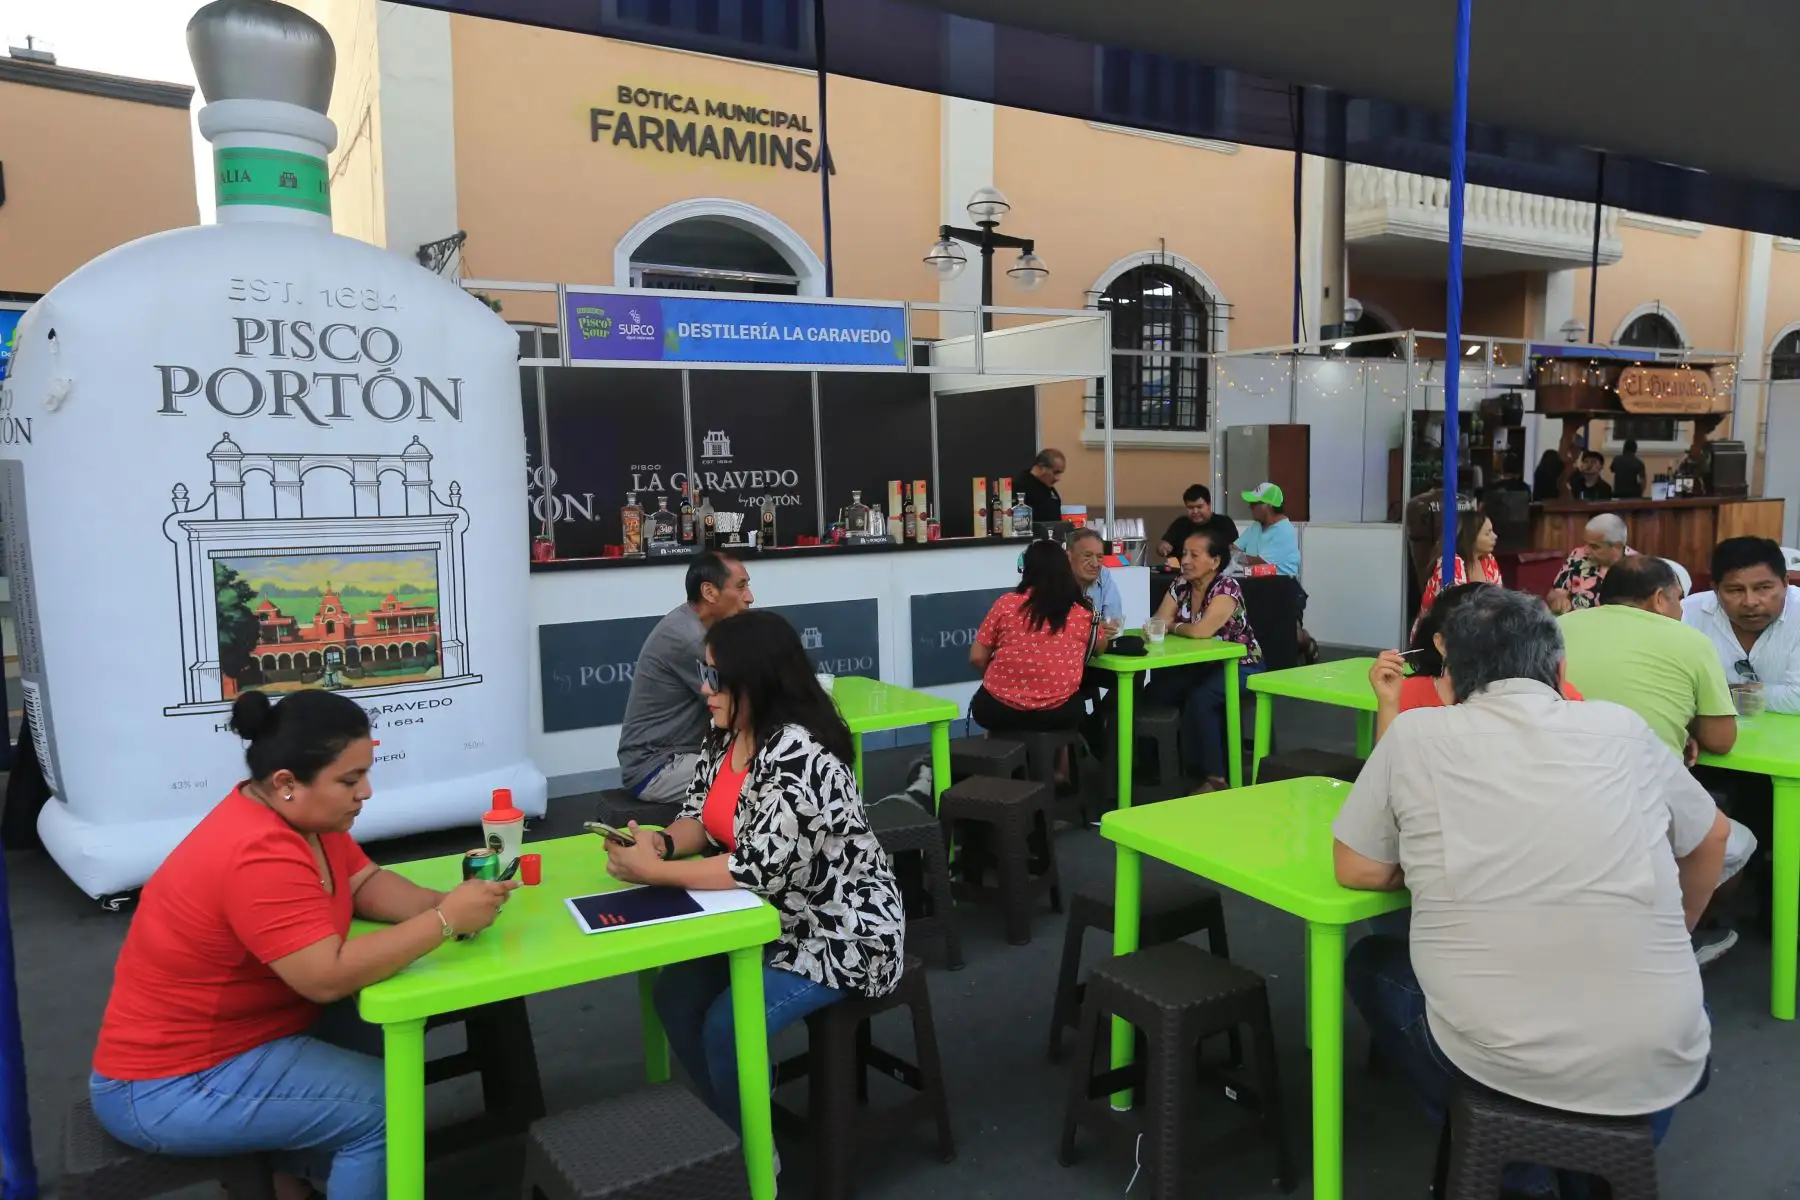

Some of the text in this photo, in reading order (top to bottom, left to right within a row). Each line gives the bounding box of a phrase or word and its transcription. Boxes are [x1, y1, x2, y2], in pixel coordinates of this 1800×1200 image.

[617, 85, 813, 133] BOTICA MUNICIPAL
[590, 107, 836, 175] FARMAMINSA
[319, 287, 402, 312] 1684
[232, 316, 402, 366] PISCO
[618, 323, 655, 336] SURCO
[678, 322, 891, 344] DESTILERÍA LA CARAVEDO
[153, 365, 465, 429] PORTÓN
[632, 473, 666, 492] LA
[749, 493, 801, 507] POTÓN
[580, 661, 639, 686] POR
[387, 717, 424, 728] 1684
[374, 750, 406, 763] PERÚ
